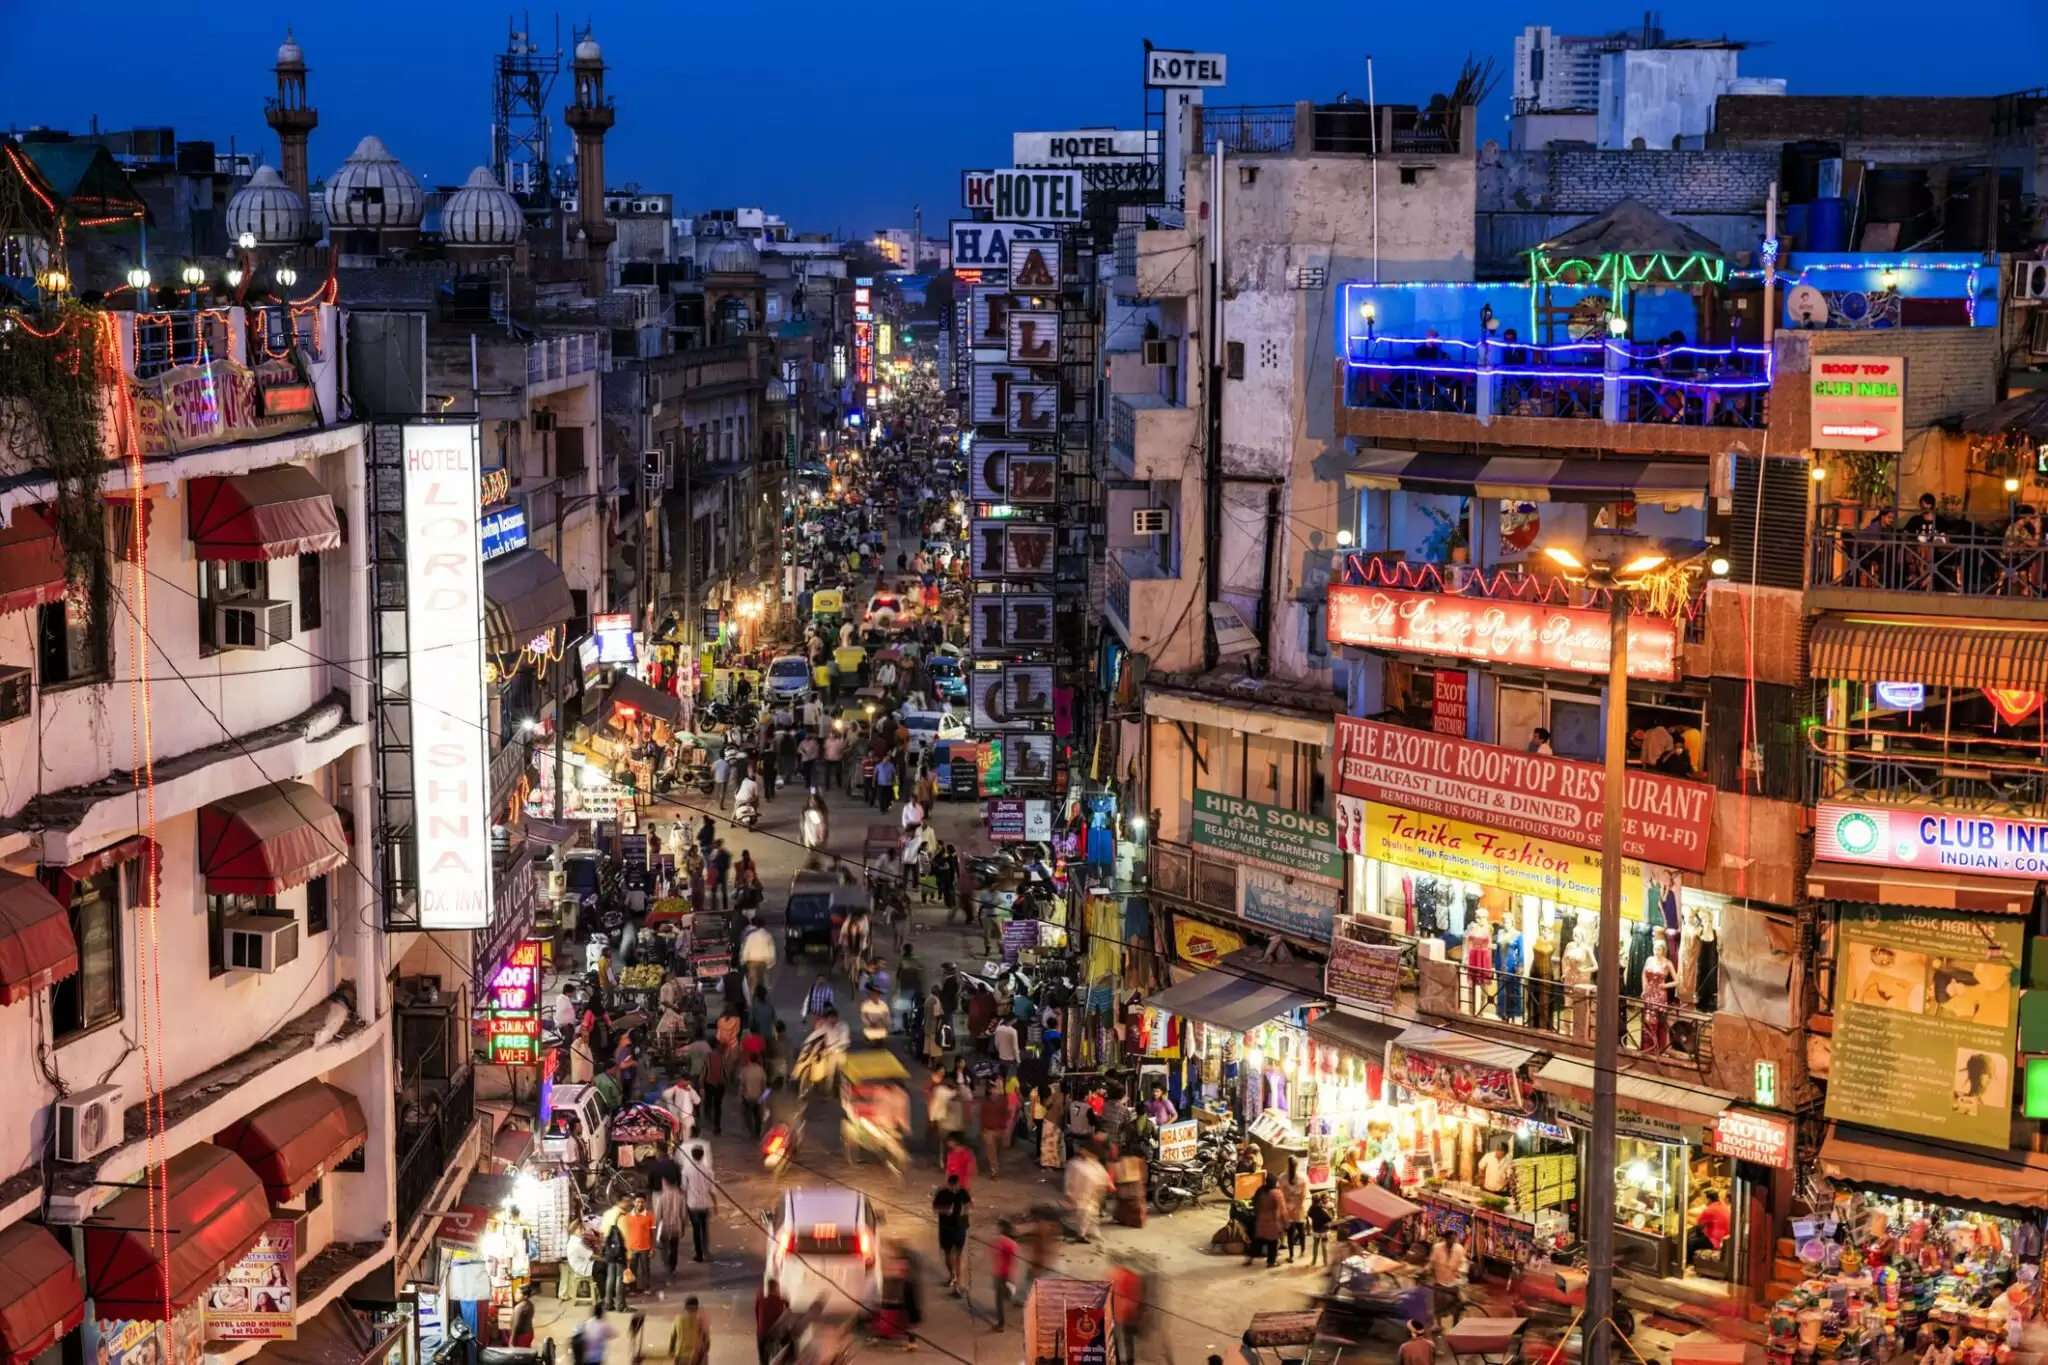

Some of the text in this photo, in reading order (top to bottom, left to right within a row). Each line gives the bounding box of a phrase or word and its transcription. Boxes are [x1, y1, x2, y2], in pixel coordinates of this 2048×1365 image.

[1153, 59, 1222, 81] HOTEL
[1051, 137, 1120, 157] HOTEL
[996, 174, 1080, 218] HOTEL
[1821, 364, 1889, 376] ROOF TOP
[1814, 381, 1899, 398] CLUB INDIA
[408, 449, 468, 471] HOTEL
[422, 483, 468, 611] LORD
[1339, 722, 1379, 758] THE
[1381, 730, 1453, 773] EXOTIC
[1456, 745, 1557, 793] ROOFTOP
[1206, 795, 1330, 837] HIRA SONS
[1344, 759, 1698, 851] BREAKFAST LUNCH & DINNER (FEE WI-FI)
[1380, 789, 1645, 854] REMEMBER US FOR DELICIOUS FOOD SECES
[1919, 816, 1995, 849] CLUB
[1205, 824, 1331, 863] READY MADE GARMENTS
[1219, 840, 1262, 857] COMPLETE
[1266, 852, 1296, 866] FAMILY
[1298, 859, 1321, 871] SHOP
[1387, 813, 1462, 849] Tanika
[1474, 832, 1570, 875] Fashion
[1418, 846, 1437, 859] High
[1439, 850, 1469, 866] Fashion
[1940, 851, 1998, 869] INDIAN
[512, 858, 534, 910] CAFE
[1247, 872, 1287, 896] HIRA
[424, 889, 483, 912] DX. INN
[1903, 914, 1939, 930] VEDIC
[499, 988, 527, 1008] TOP
[496, 1035, 530, 1049] FREE
[499, 1049, 529, 1061] WI-FI
[1718, 1117, 1785, 1147] EXOTIC
[1722, 1133, 1777, 1154] ROOFTOP
[1715, 1142, 1784, 1168] RESTAURANT
